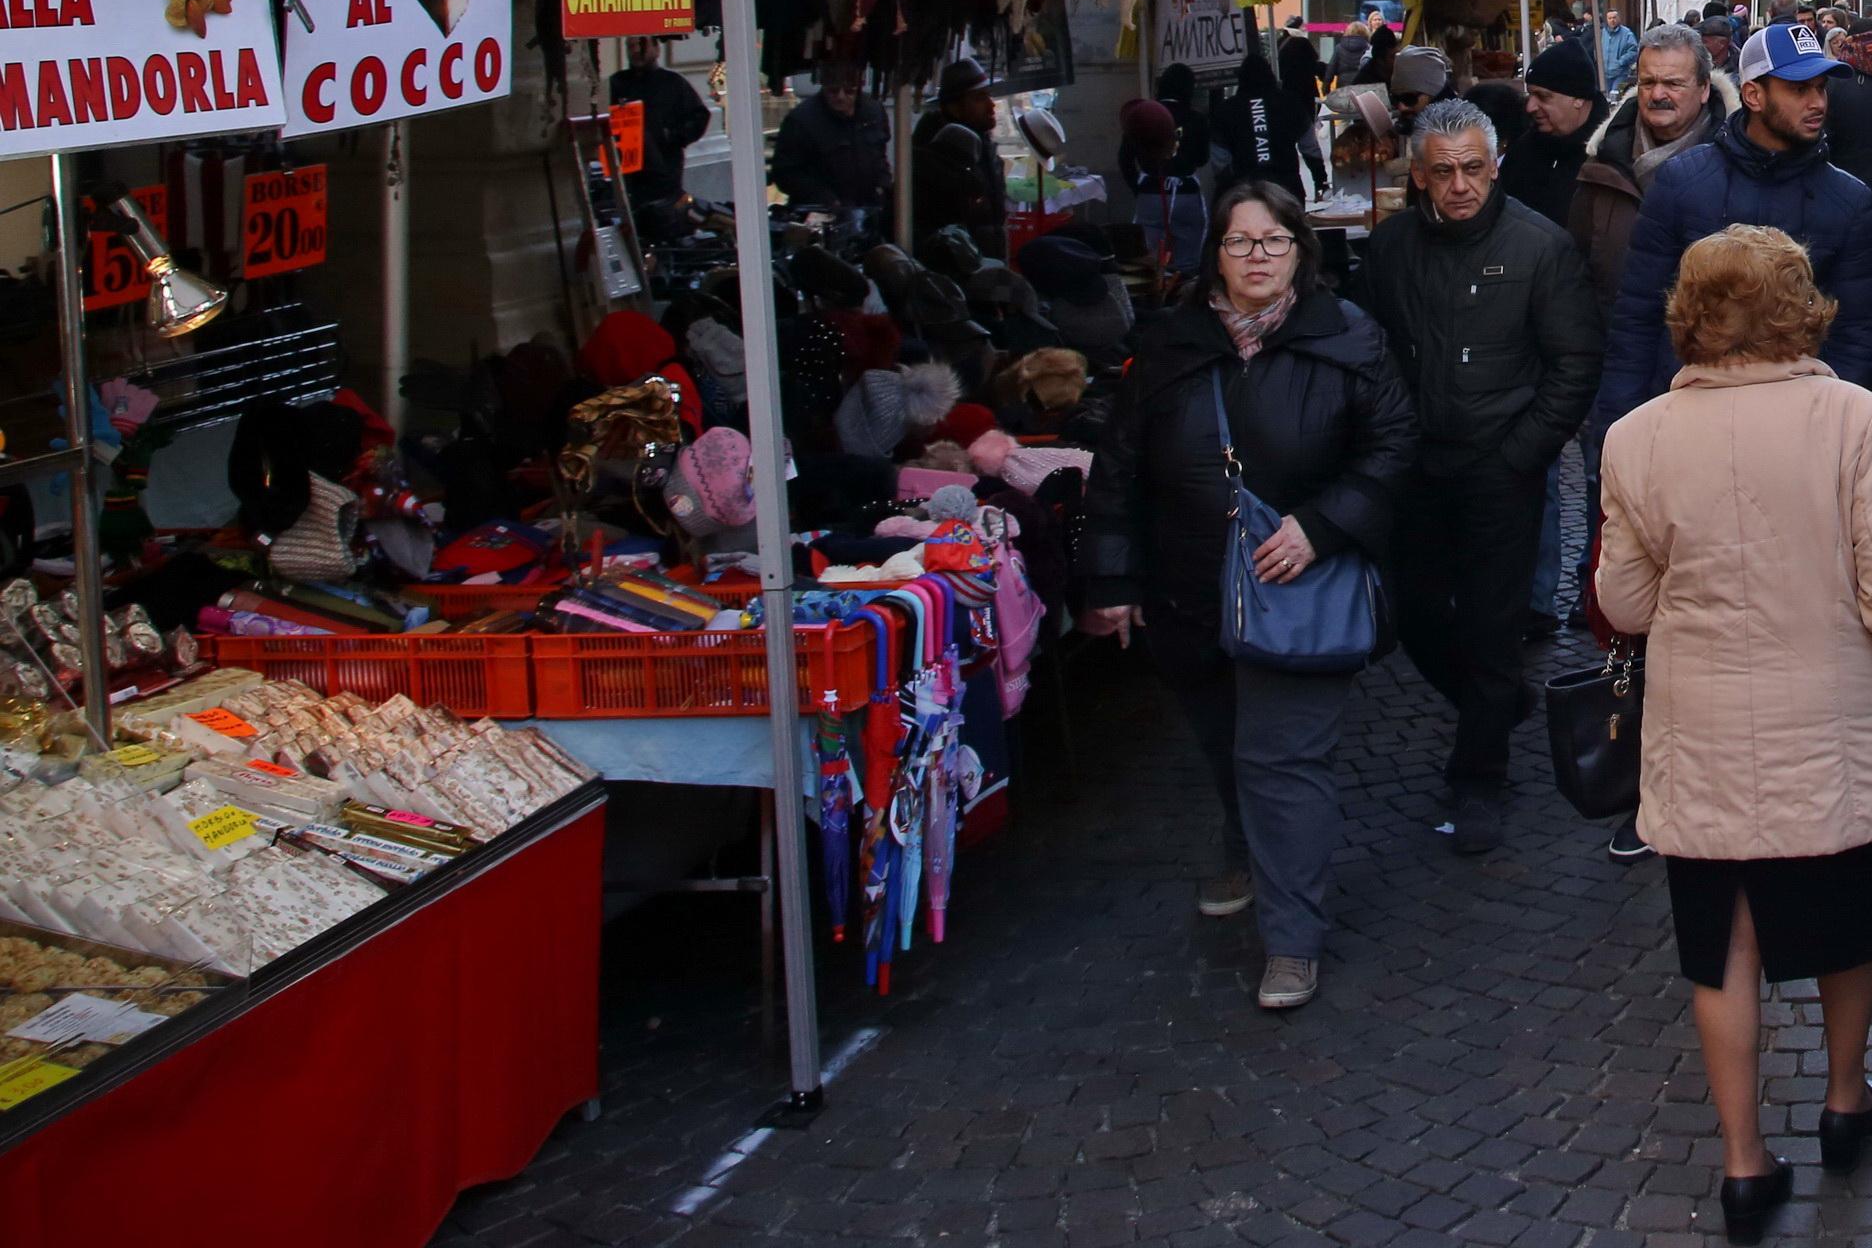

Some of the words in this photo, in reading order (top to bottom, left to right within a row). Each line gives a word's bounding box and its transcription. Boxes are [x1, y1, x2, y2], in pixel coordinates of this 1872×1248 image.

[302, 37, 502, 123] COCCO
[1249, 98, 1267, 132] NIKE
[1256, 137, 1271, 163] AIR
[251, 172, 323, 202] BORSE
